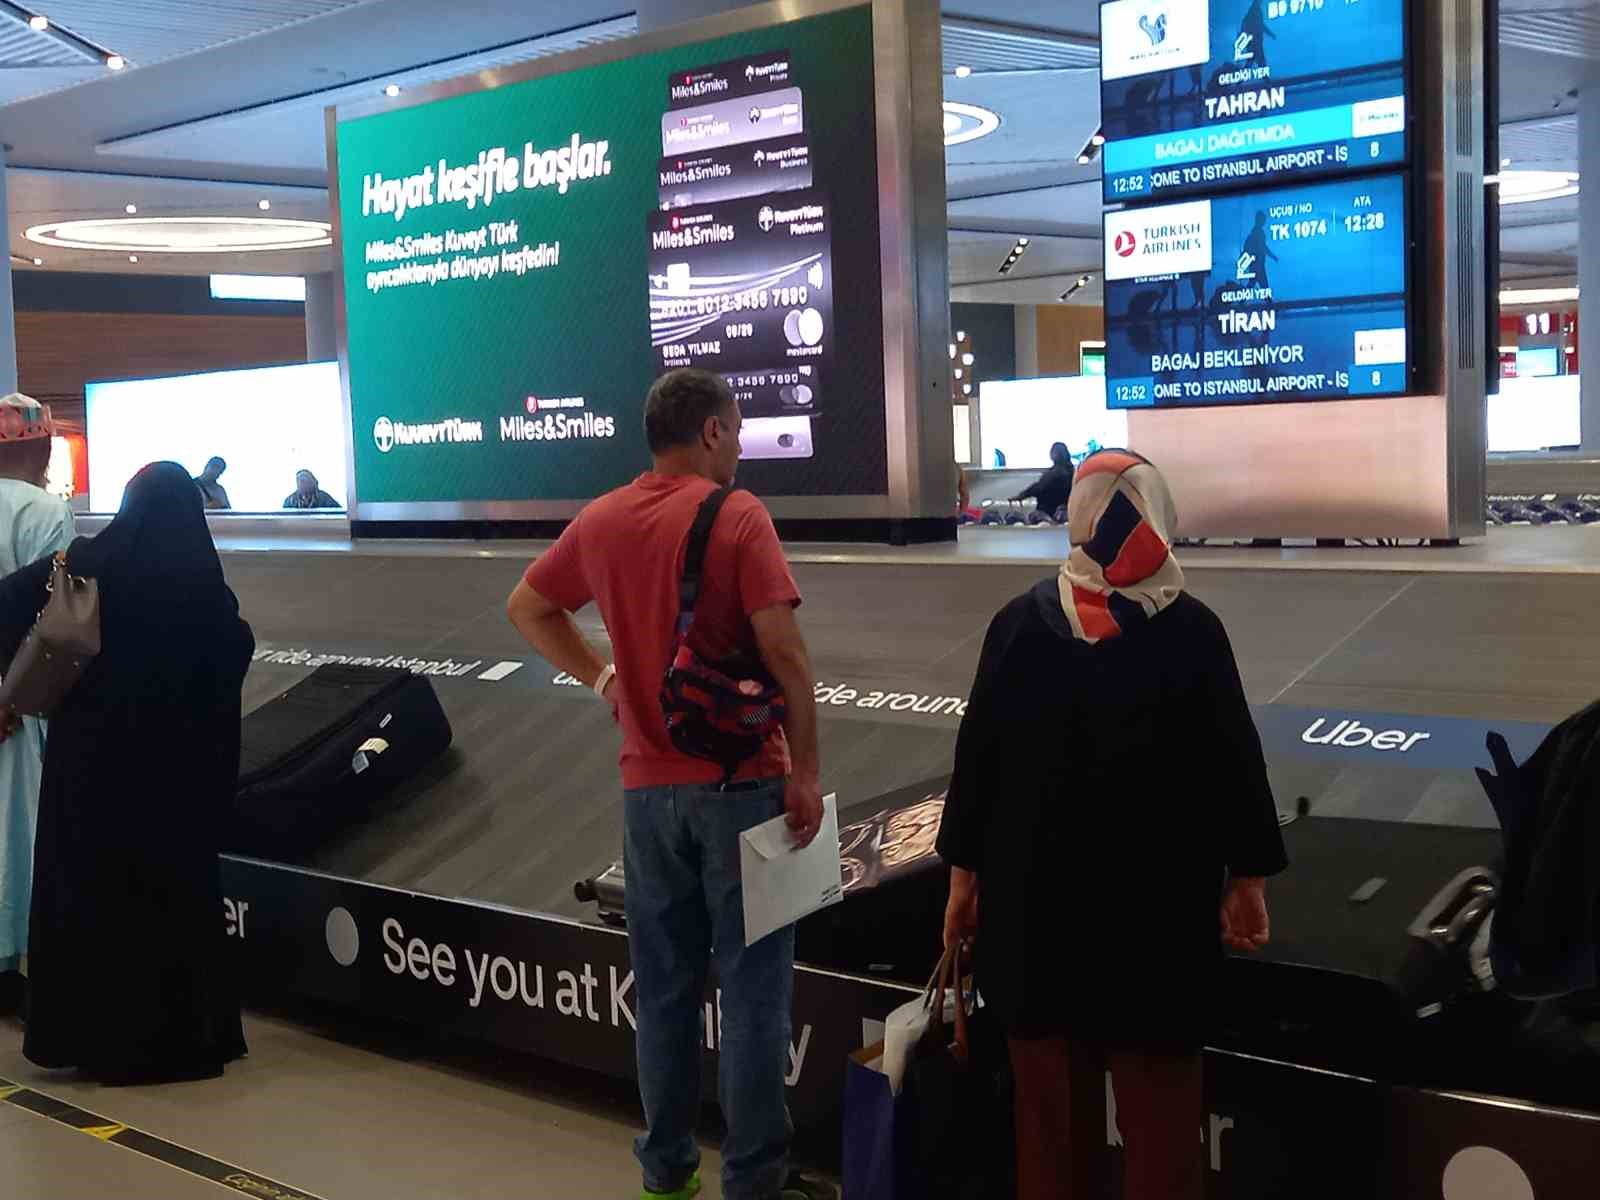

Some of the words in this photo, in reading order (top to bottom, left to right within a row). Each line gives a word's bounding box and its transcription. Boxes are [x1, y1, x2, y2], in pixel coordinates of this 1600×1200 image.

[1252, 66, 1270, 80] YER
[1204, 87, 1285, 120] TAHRAN
[1155, 137, 1204, 160] BAGAJ
[362, 165, 435, 222] Hayat
[437, 148, 519, 210] keşifle
[523, 133, 612, 195] başlar.
[1182, 168, 1199, 182] TO
[1202, 158, 1264, 180] ISTANBUL
[1266, 149, 1325, 172] AIRPORT
[1113, 175, 1143, 193] 12:52
[489, 219, 519, 245] Türk
[652, 224, 735, 250] Miles&Smiles
[1143, 222, 1201, 240] TURKISH
[1270, 224, 1290, 240] TK
[1294, 219, 1327, 238] 1074
[1142, 238, 1201, 255] AIRLINES
[1254, 287, 1272, 300] YER
[1218, 309, 1276, 334] TİRAN
[1526, 312, 1550, 335] 11
[1152, 352, 1200, 372] BAGAJ
[1203, 344, 1304, 369] BEKLENİYOR
[1154, 382, 1181, 399] OME
[1184, 381, 1201, 396] TO
[1203, 377, 1265, 396] ISTANBUL
[1267, 373, 1325, 392] AIRPORT
[1371, 370, 1381, 386] 8
[1115, 386, 1146, 401] 12:52
[500, 412, 615, 442] Miles&Smiles
[1302, 718, 1431, 751] Uber
[382, 917, 457, 986] See
[464, 949, 545, 1008] you
[555, 963, 600, 1022] at
